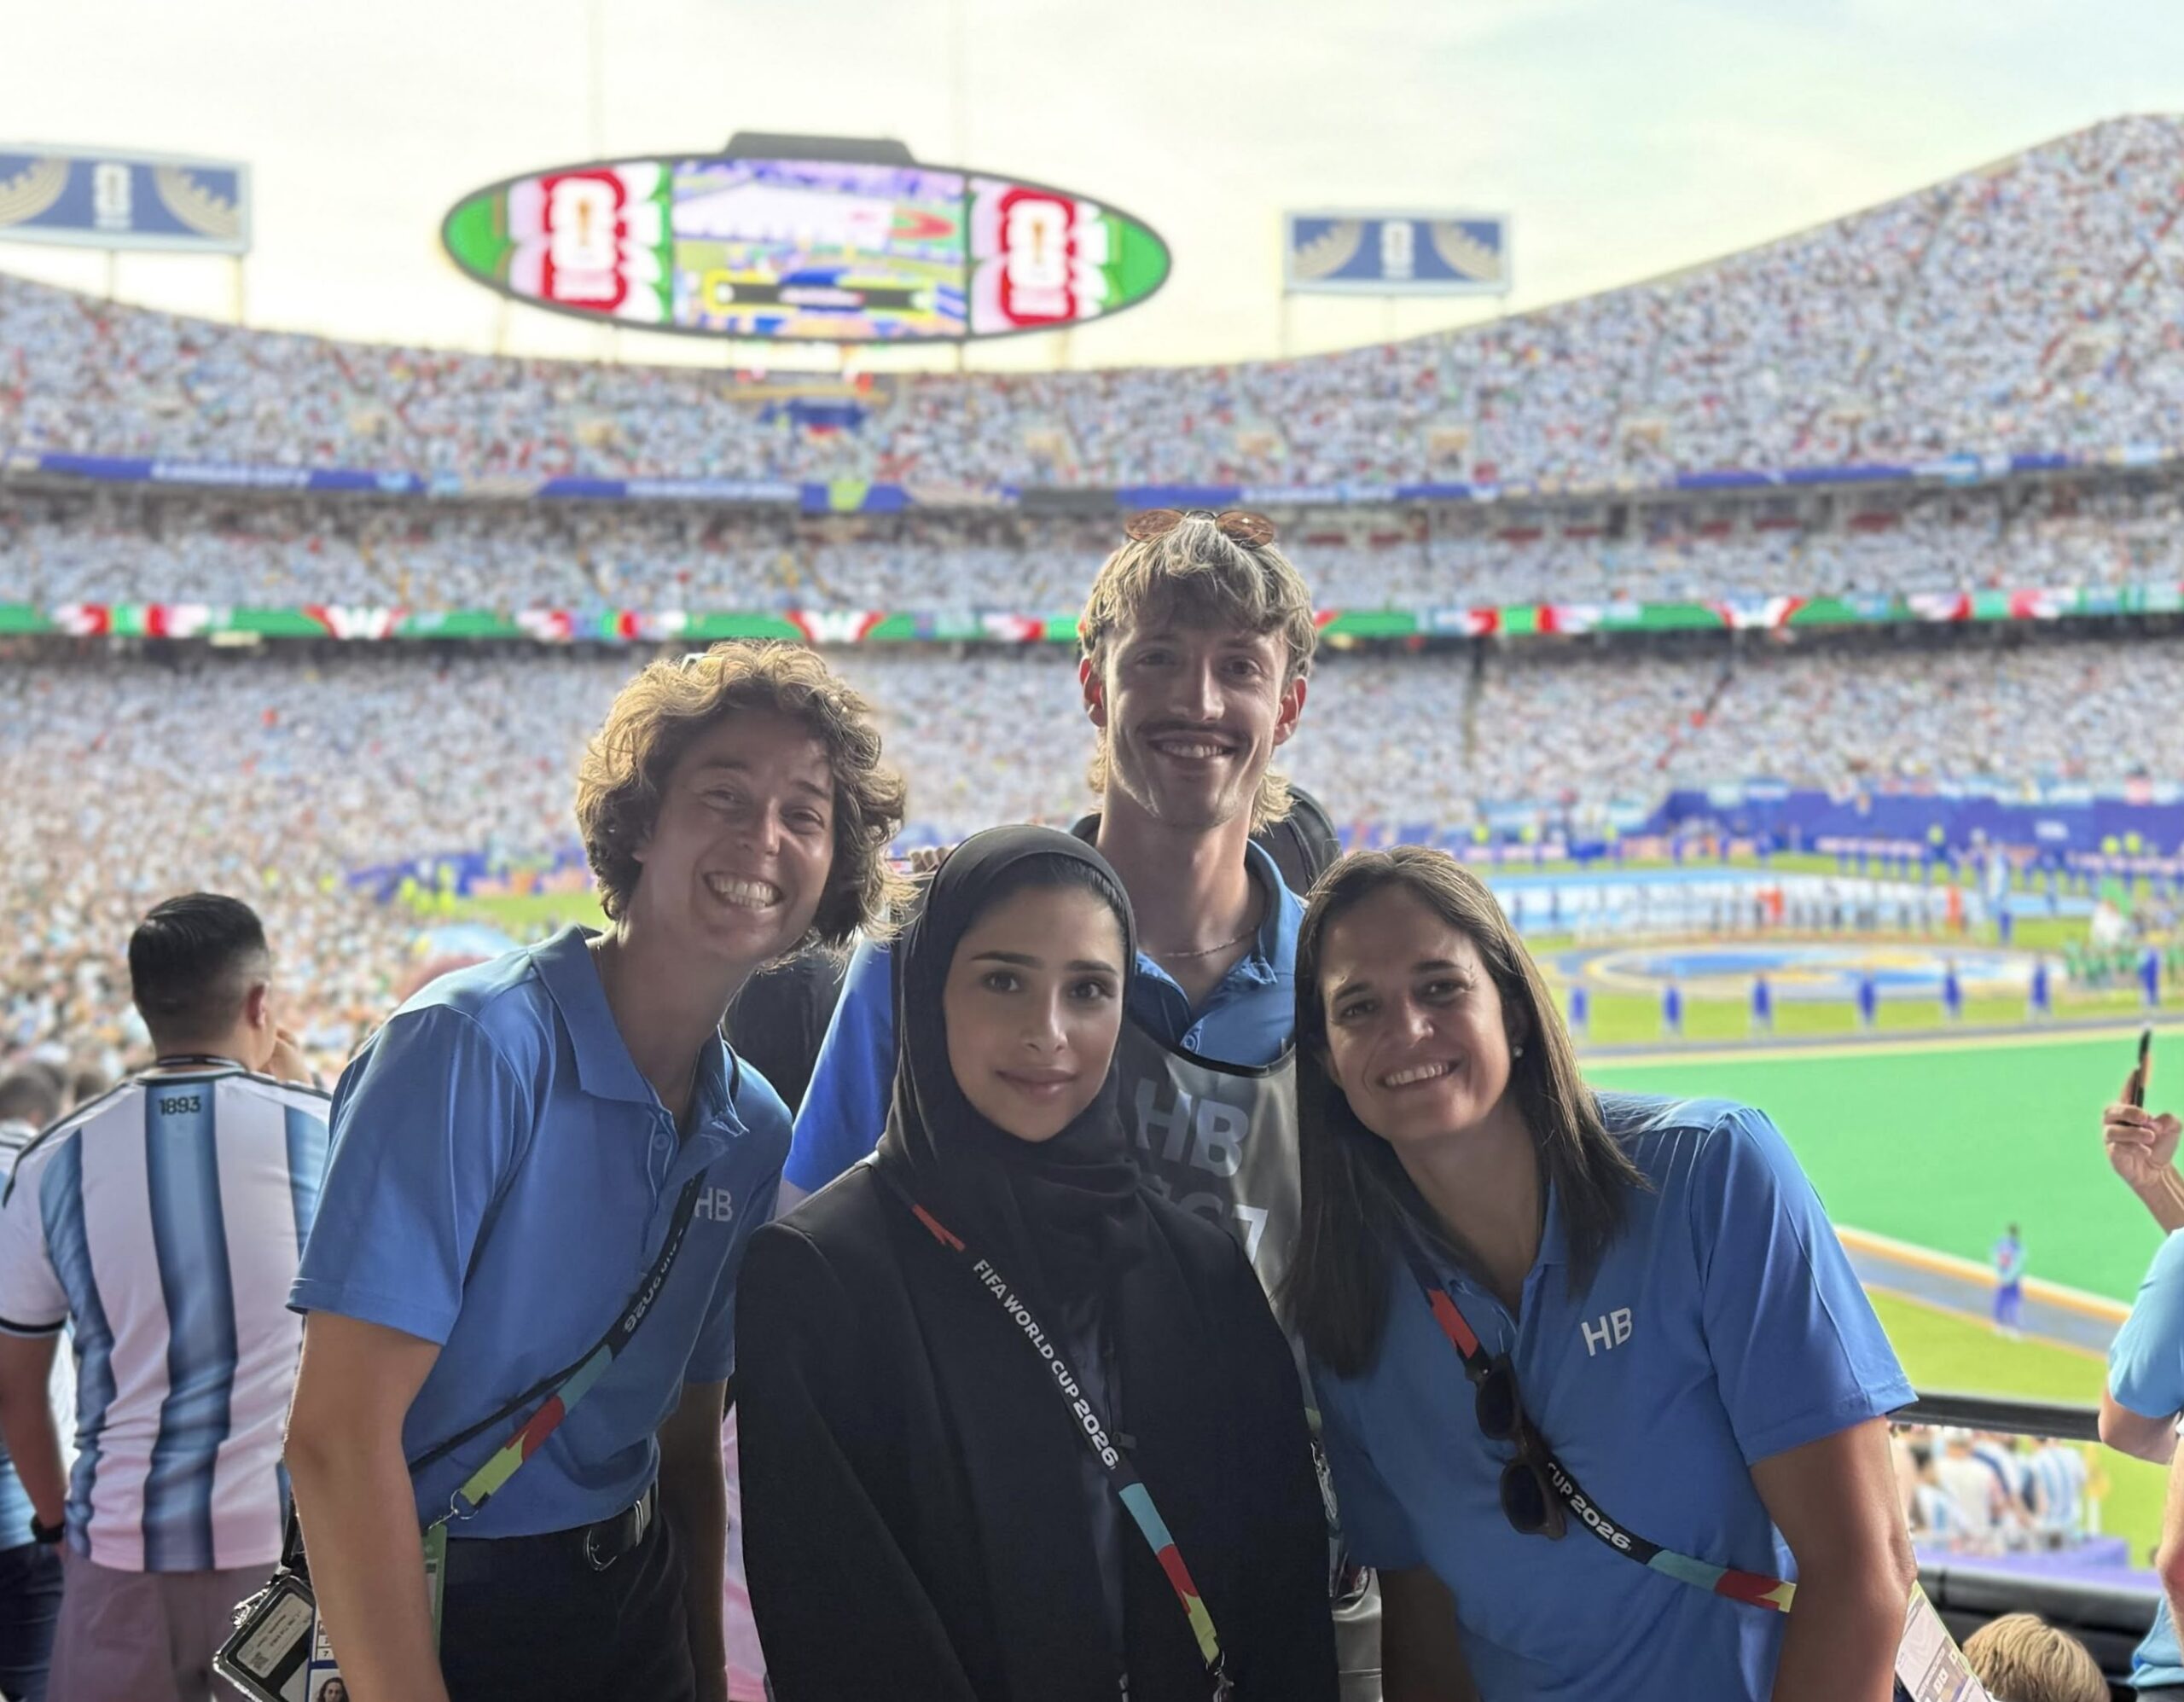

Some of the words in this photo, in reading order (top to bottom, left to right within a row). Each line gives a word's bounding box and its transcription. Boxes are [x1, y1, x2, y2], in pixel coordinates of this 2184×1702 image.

[159, 1095, 201, 1115] 1893
[1135, 1078, 1249, 1177] HB
[694, 1187, 733, 1222] HB
[1581, 1307, 1632, 1357] HB
[973, 1259, 1007, 1299] FIFA
[1003, 1294, 1054, 1359] WORLD
[1051, 1360, 1079, 1397] CUP
[1073, 1399, 1119, 1467] 2026
[1570, 1495, 1631, 1550] 2026
